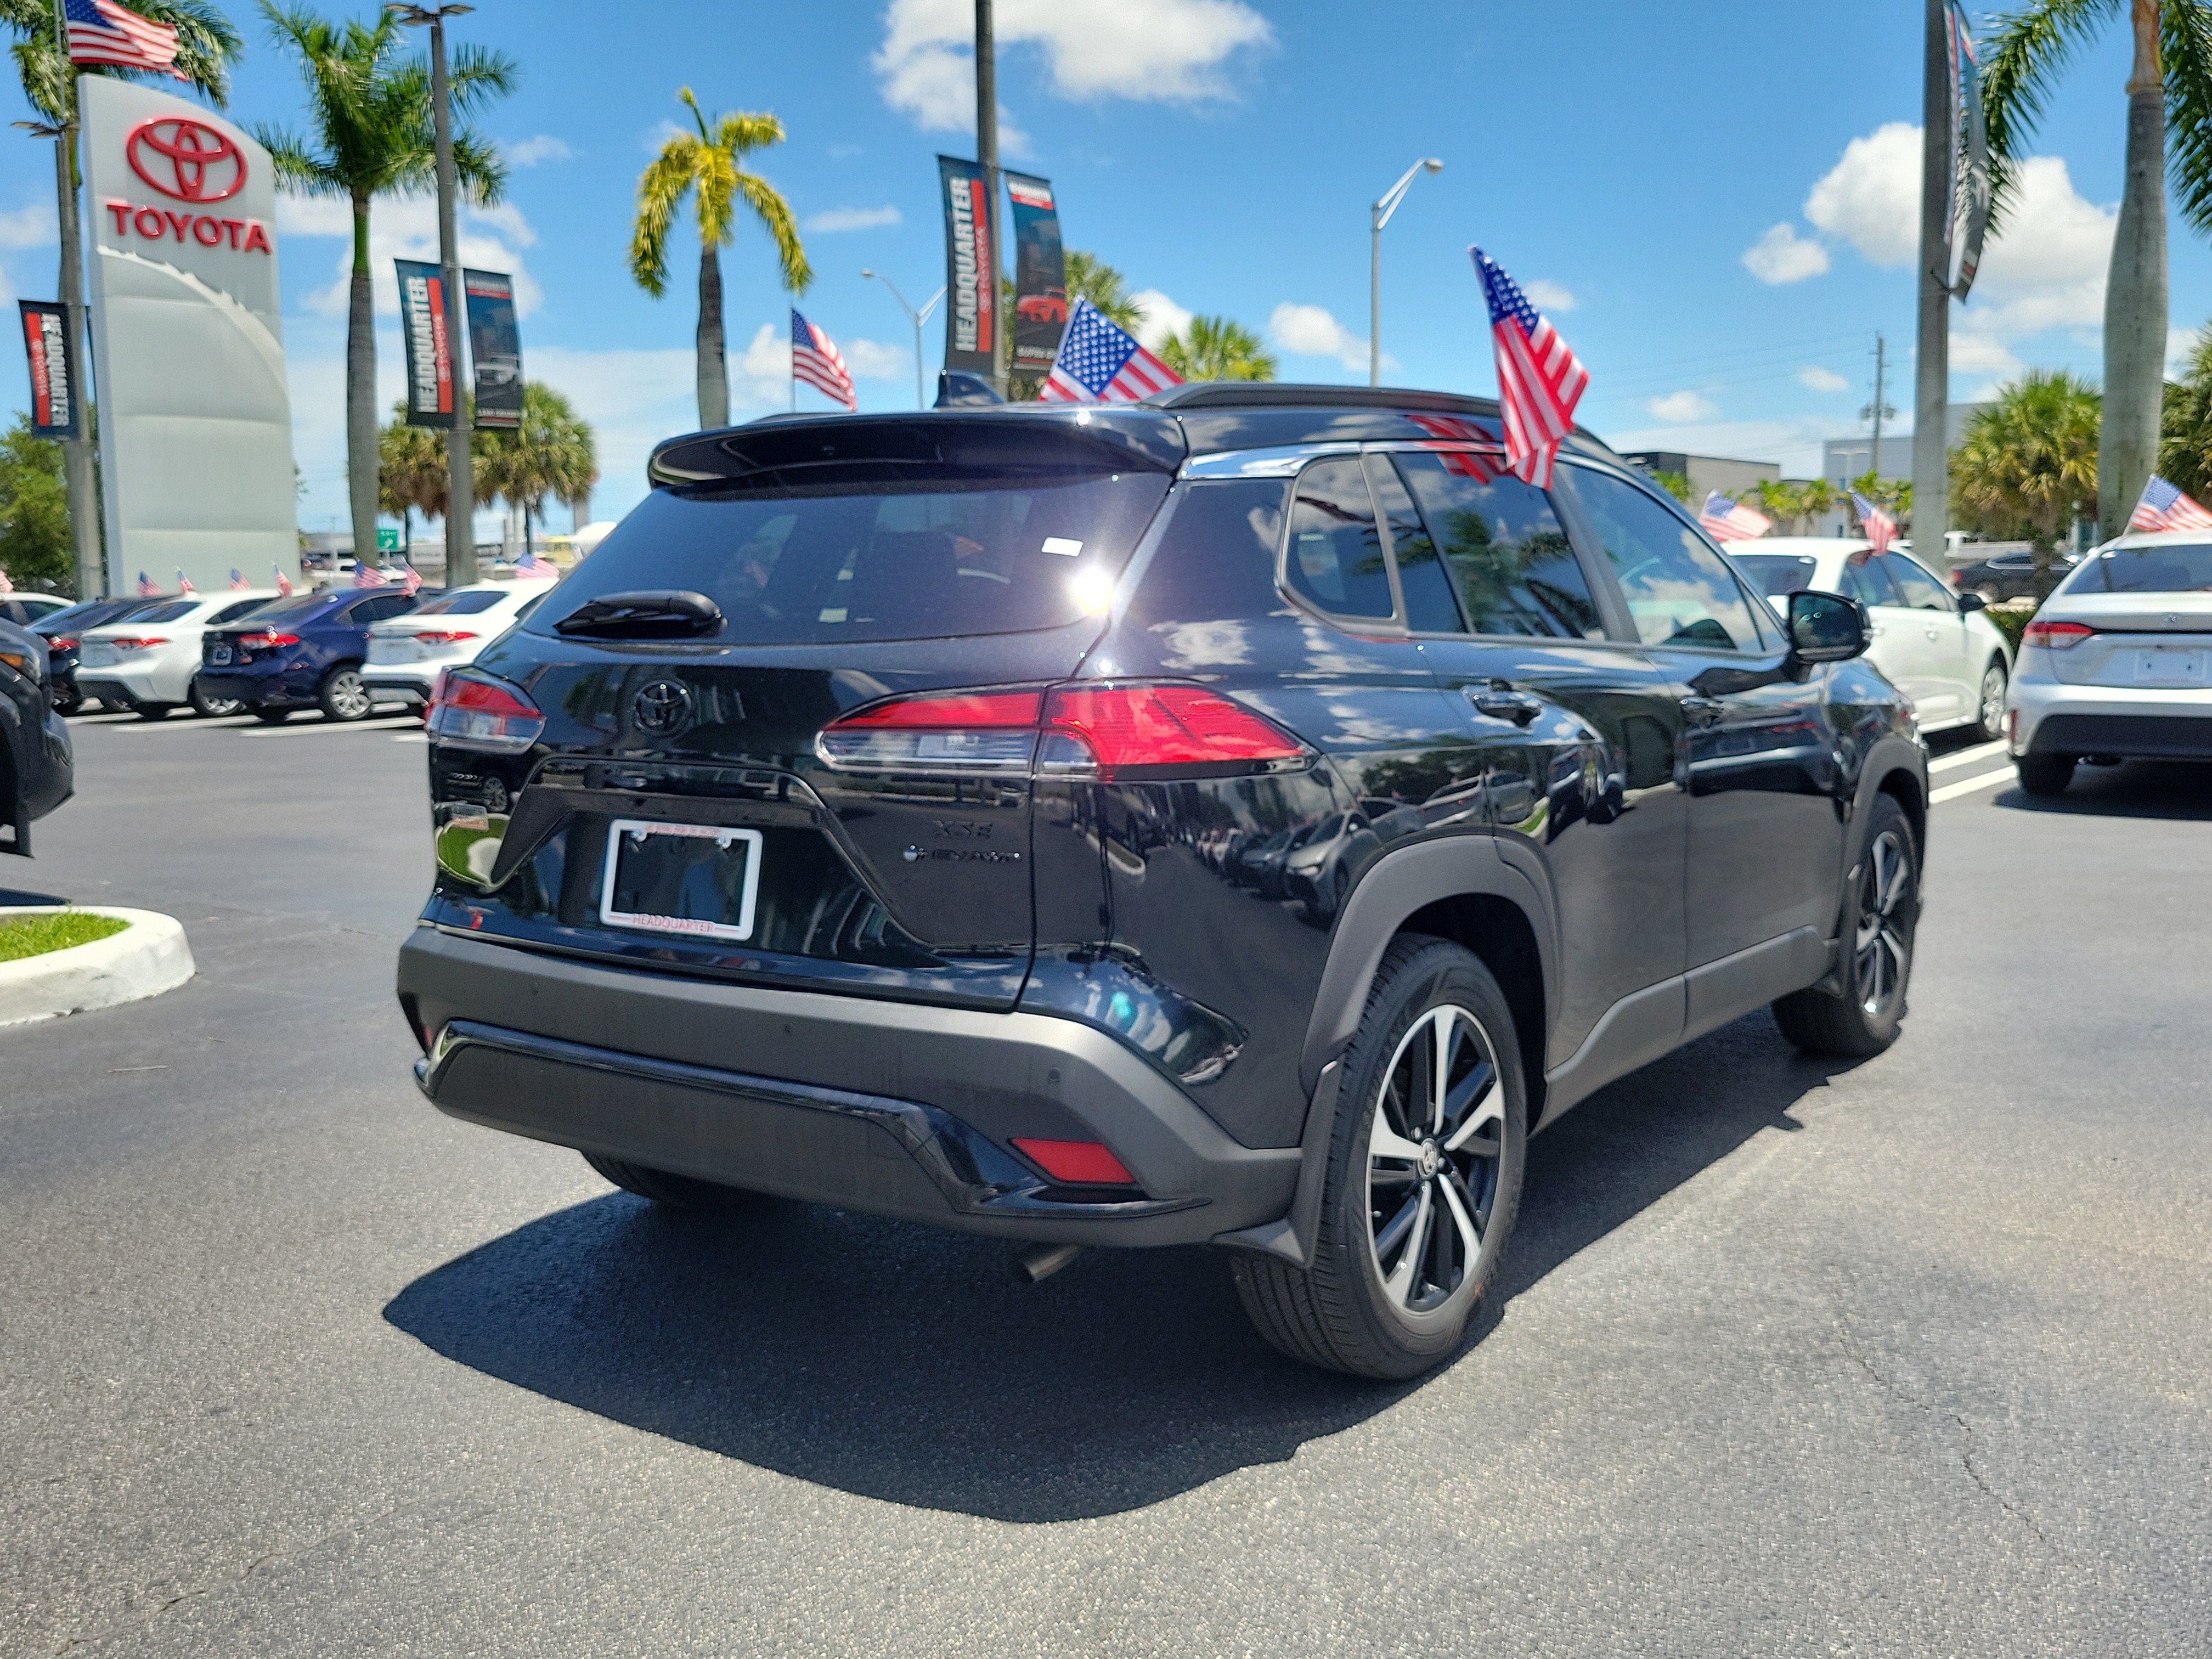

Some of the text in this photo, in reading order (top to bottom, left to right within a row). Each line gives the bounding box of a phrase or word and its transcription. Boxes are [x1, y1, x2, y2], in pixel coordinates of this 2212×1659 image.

[106, 200, 272, 255] TOYOTA
[949, 177, 978, 352] HEADQUARTER
[41, 313, 70, 426] HEADQUARTER
[408, 275, 438, 413] HEADQUARTER
[632, 913, 714, 933] HEADQUARTER
